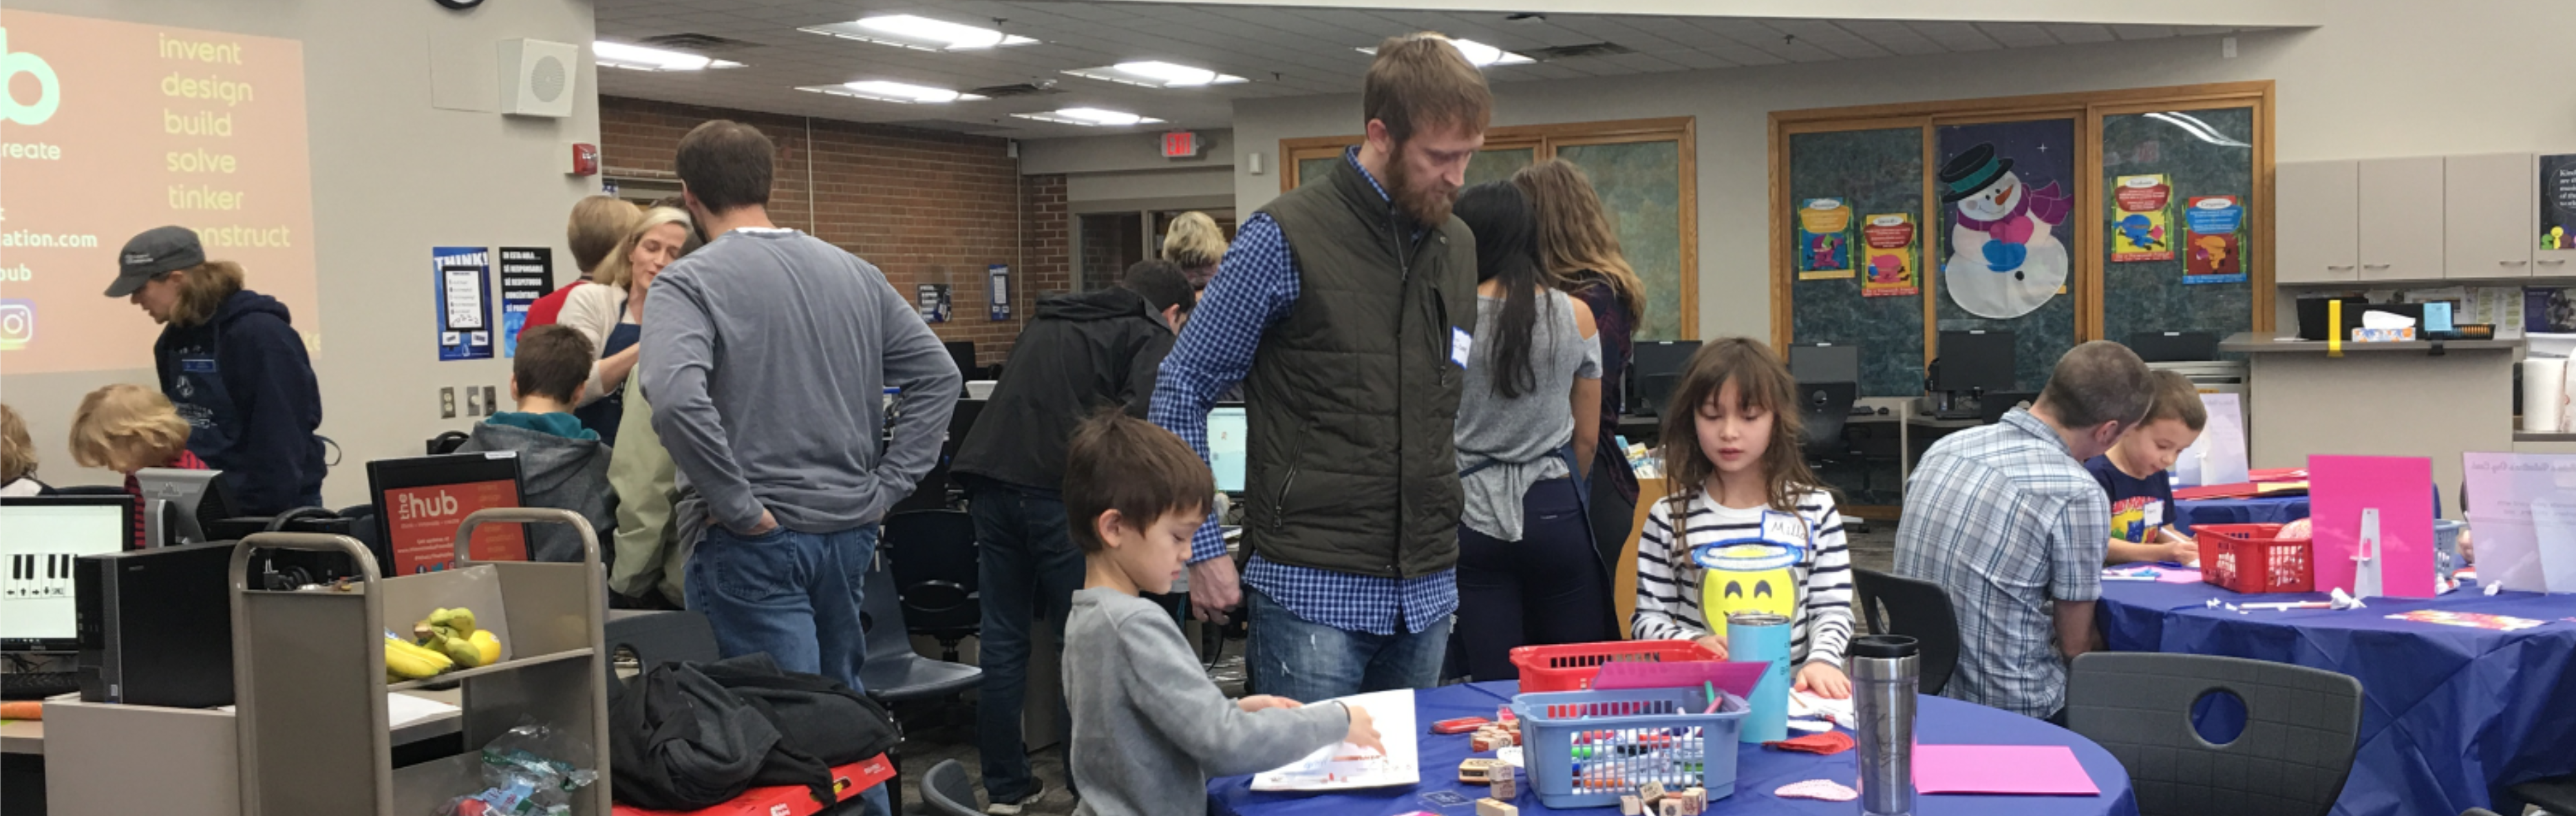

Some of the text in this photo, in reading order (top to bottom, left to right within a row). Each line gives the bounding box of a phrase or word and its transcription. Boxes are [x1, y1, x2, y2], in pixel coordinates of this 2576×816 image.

[159, 32, 242, 65] invent
[161, 71, 253, 107] design
[164, 107, 232, 136] build
[0, 142, 61, 160] reate
[1167, 133, 1191, 156] EXIT
[166, 147, 236, 174] solve
[168, 184, 244, 211] tinker
[0, 229, 98, 248] ation.com
[191, 224, 291, 247] onstruct
[434, 251, 489, 271] THINK!
[398, 493, 410, 520] the
[409, 490, 458, 518] hub
